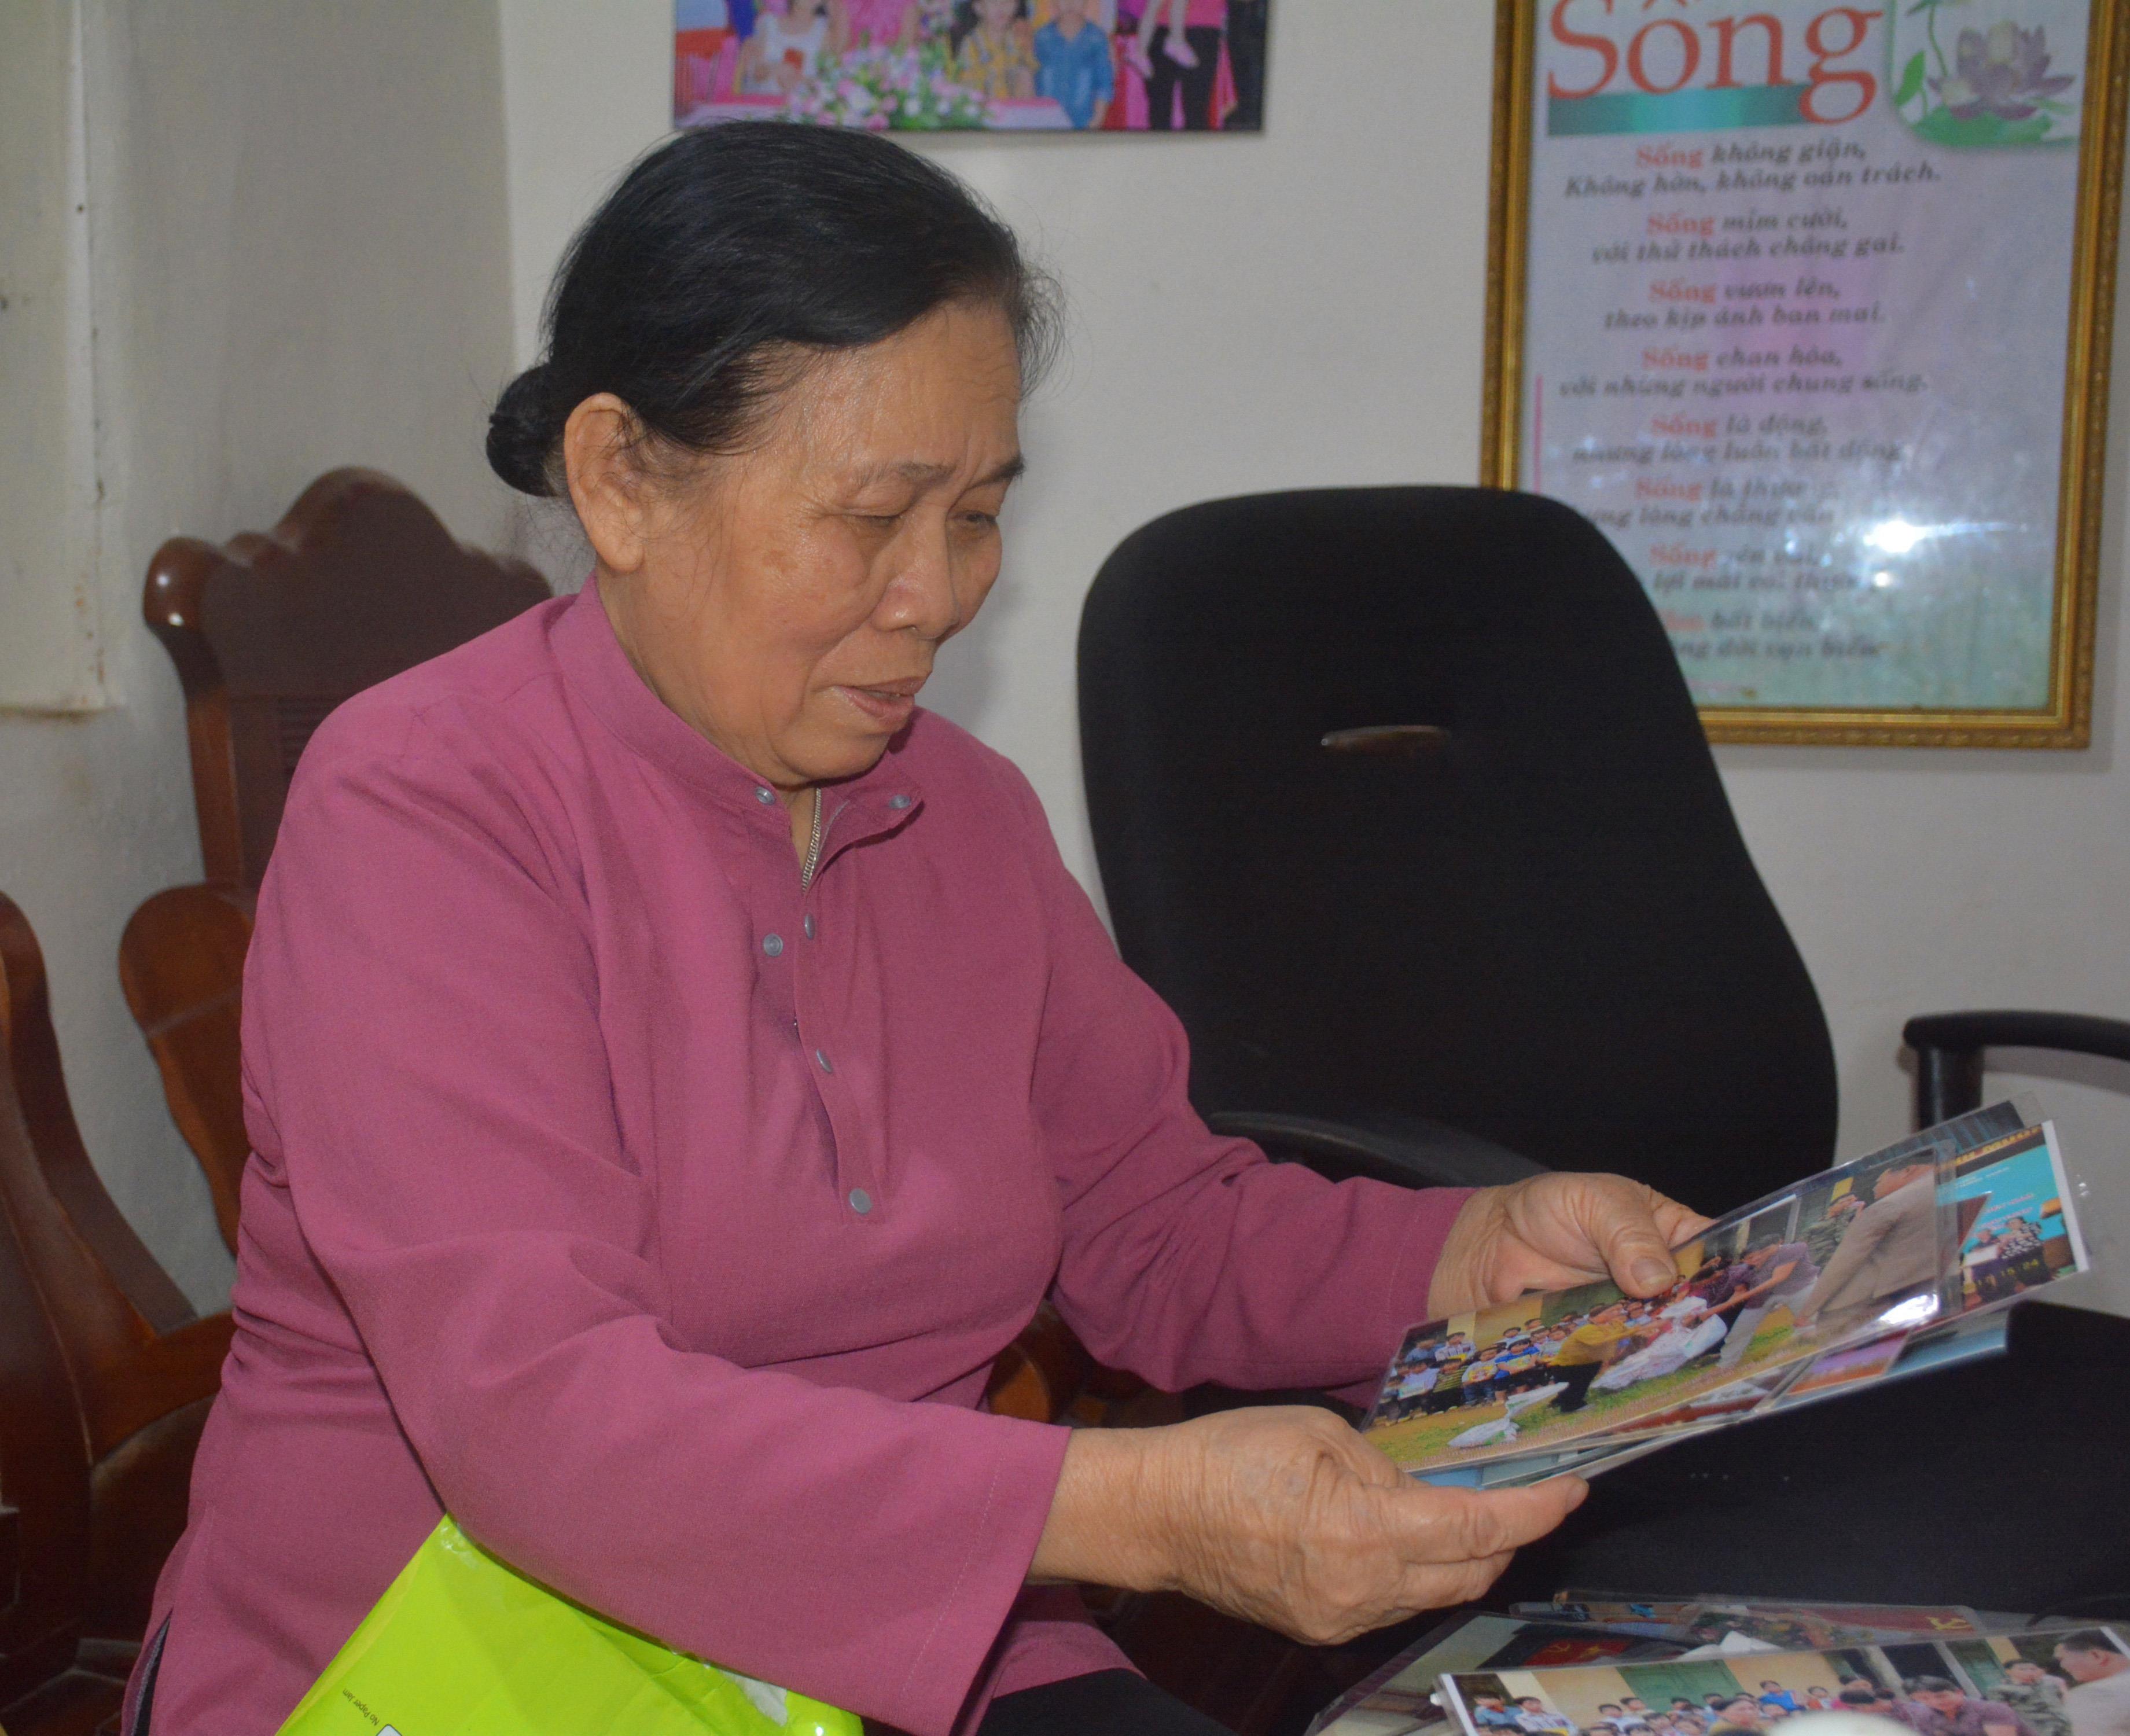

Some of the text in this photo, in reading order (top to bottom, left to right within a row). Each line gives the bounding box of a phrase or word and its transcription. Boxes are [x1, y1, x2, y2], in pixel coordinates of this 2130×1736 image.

[343, 1688, 380, 1726] No Paper Jam
